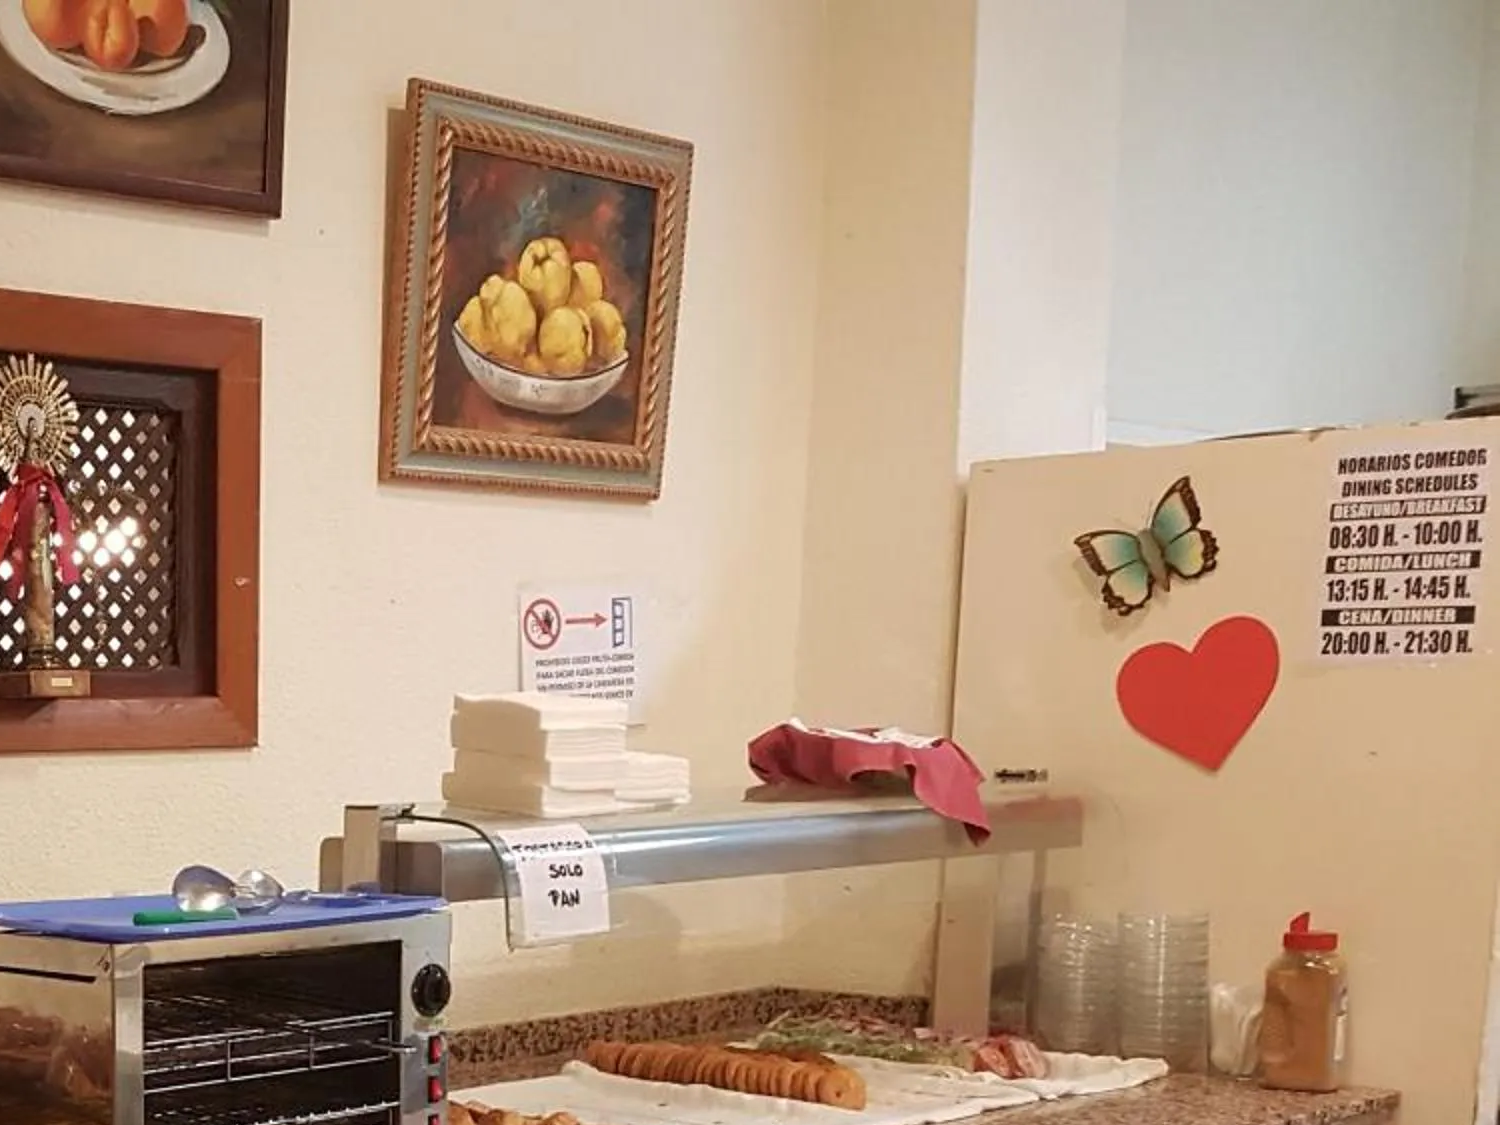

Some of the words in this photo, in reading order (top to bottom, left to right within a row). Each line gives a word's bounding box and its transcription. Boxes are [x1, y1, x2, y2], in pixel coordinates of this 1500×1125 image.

[1338, 453, 1411, 475] HORARIOS
[1415, 449, 1487, 471] COMEDOR
[1342, 478, 1392, 498] DINING
[1395, 473, 1478, 495] SCHEDULES
[1329, 524, 1379, 549] 08:30
[1383, 524, 1398, 546] H.
[1413, 520, 1462, 545] 10:00
[1466, 519, 1483, 543] H.
[1334, 552, 1472, 572] COMIDA/LUNCH
[1326, 577, 1369, 602] 13:15
[1373, 577, 1388, 601] H.
[1403, 576, 1450, 600] 14:45
[1453, 575, 1471, 599] H.
[1338, 607, 1457, 625] CENA/DINNER
[1321, 631, 1370, 656] 20:00
[1374, 631, 1390, 654] H.
[1403, 630, 1451, 654] 21:30
[1455, 629, 1473, 653] H.
[548, 864, 583, 879] SOLO
[547, 888, 580, 908] PAN
